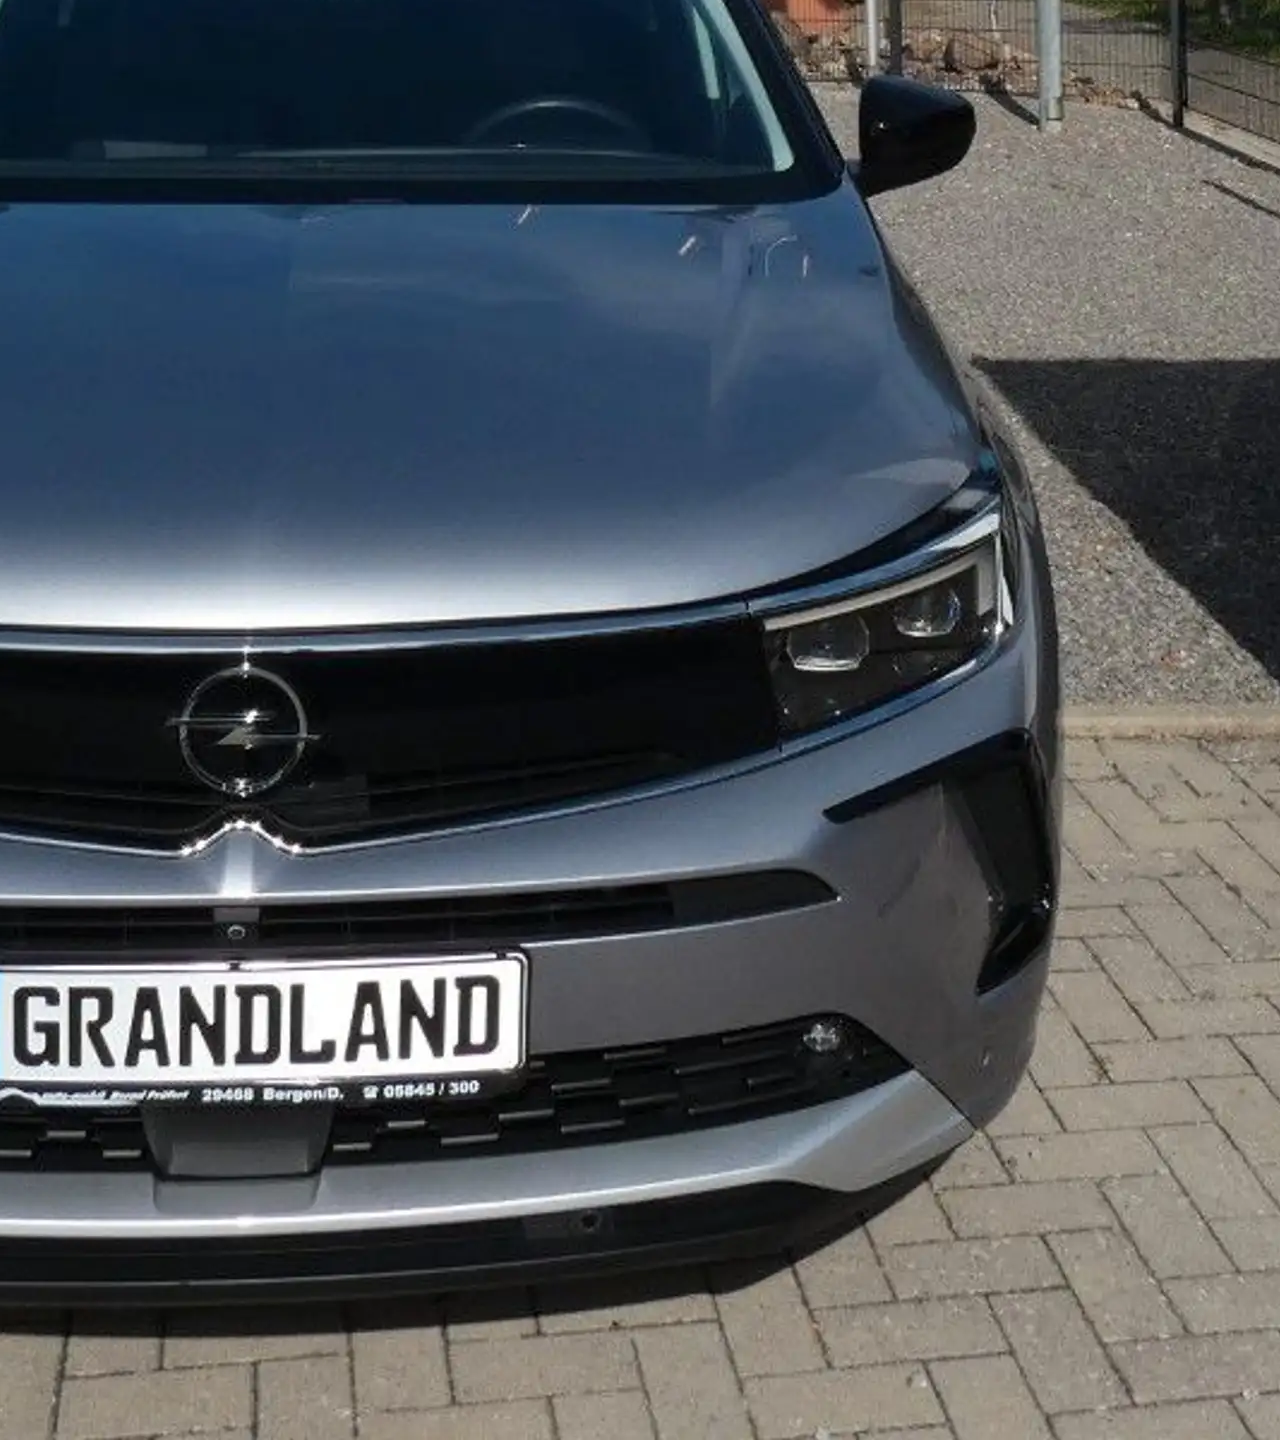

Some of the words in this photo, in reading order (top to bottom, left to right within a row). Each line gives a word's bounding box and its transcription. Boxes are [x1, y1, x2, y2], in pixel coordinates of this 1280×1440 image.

[12, 974, 501, 1067] GRANDLAND
[201, 1087, 255, 1102] 29468
[383, 1081, 436, 1099] 05845
[448, 1078, 481, 1096] 300
